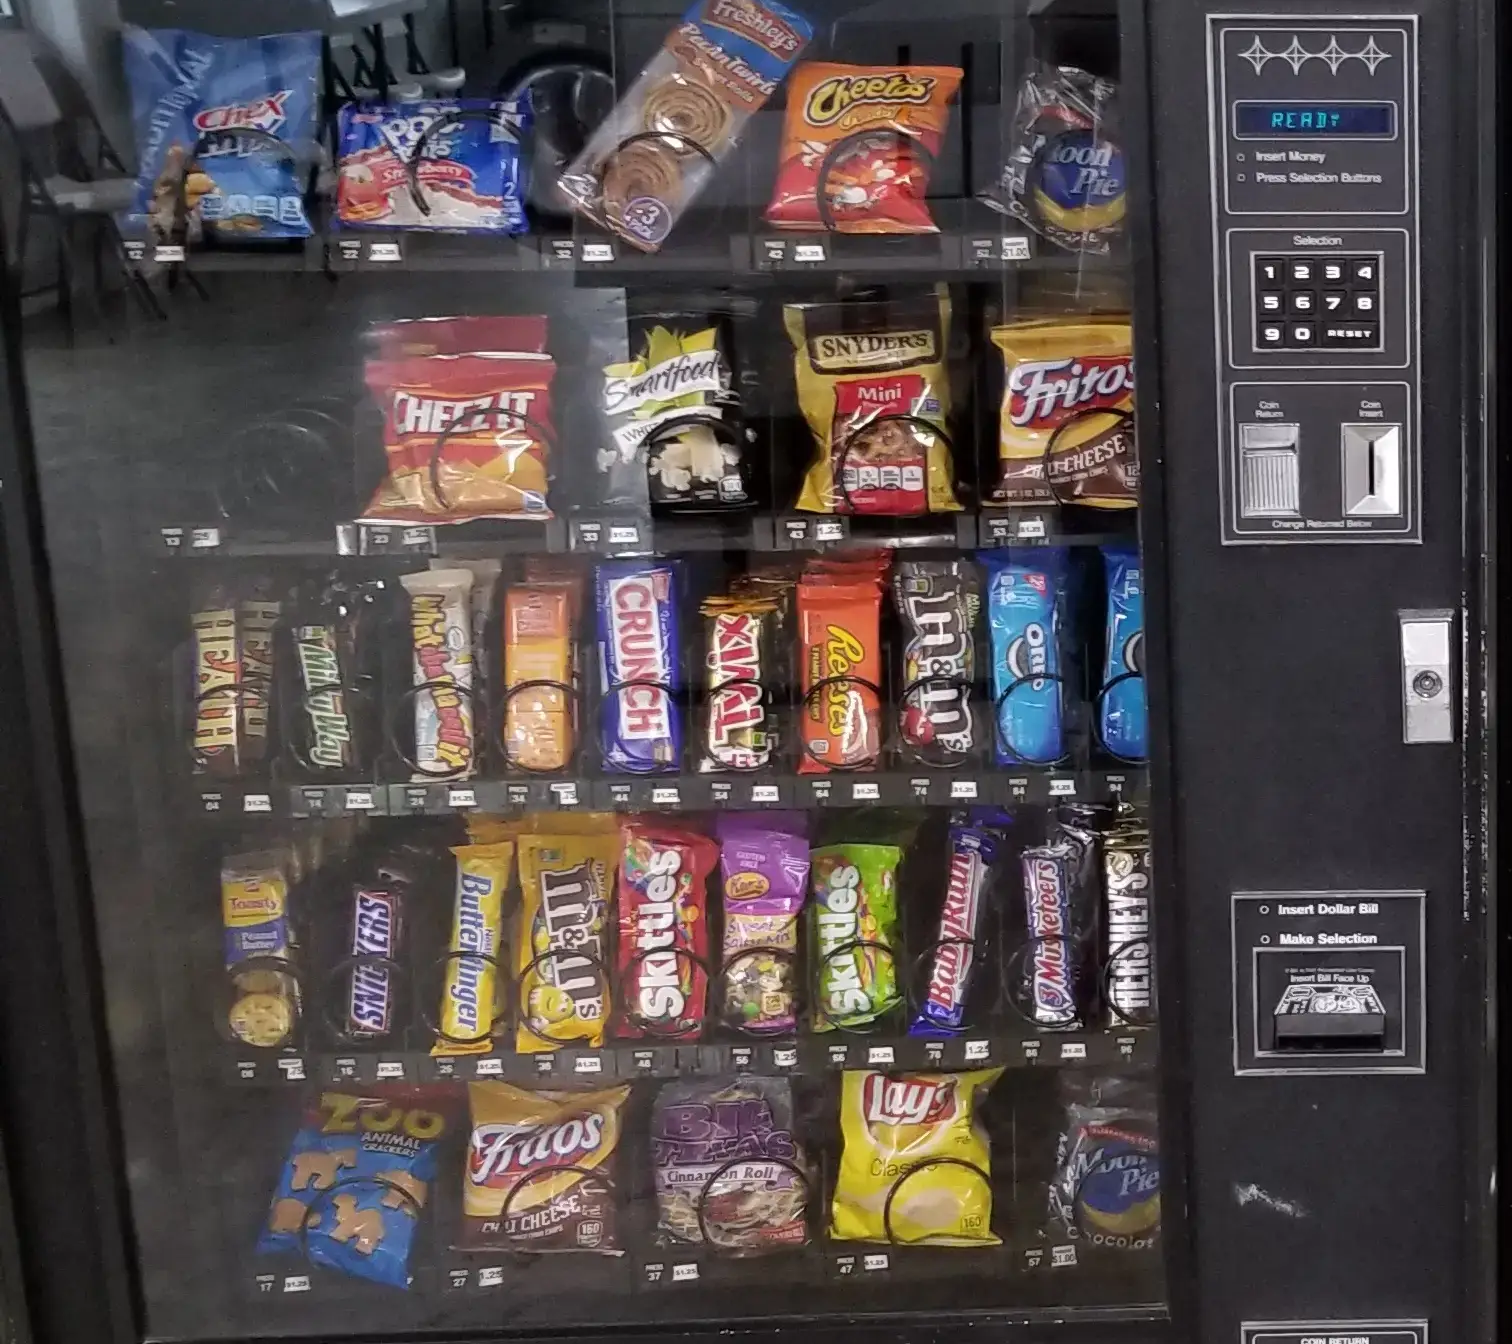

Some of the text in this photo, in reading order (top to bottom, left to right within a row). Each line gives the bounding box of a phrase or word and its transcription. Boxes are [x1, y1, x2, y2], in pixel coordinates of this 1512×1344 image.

[727, 54, 779, 97] Twirls
[806, 75, 936, 125] Cheetos
[196, 90, 295, 134] Chex
[1271, 112, 1340, 129] READY
[1256, 152, 1326, 164] Insert Money
[1070, 168, 1120, 196] Pie
[1256, 172, 1382, 184] Press Selection Buttons
[1293, 235, 1343, 247] Selection
[1264, 267, 1276, 279] 1
[1294, 267, 1310, 279] 2
[1325, 267, 1341, 279] 3
[1357, 267, 1372, 279] 4
[1263, 297, 1279, 309] 5
[1295, 297, 1310, 309] 6
[1325, 297, 1341, 310] 7
[1357, 297, 1372, 309] 8
[1264, 328, 1280, 341] 9
[1295, 328, 1311, 340] 0
[1328, 330, 1372, 338] RESET
[822, 332, 930, 358] SNYDER'S
[603, 355, 719, 412] Smartfood
[857, 382, 902, 402] Mini
[1064, 433, 1126, 473] CHEESE
[1272, 519, 1305, 530] Change
[613, 584, 666, 734] CRUNCH
[1024, 624, 1046, 691] OREO
[710, 613, 765, 748] TWIX
[826, 624, 866, 736] Reese's
[308, 712, 351, 768] Way
[914, 786, 928, 796] 74
[731, 878, 767, 895] Kar's
[1278, 903, 1379, 915] Insert Dollar Bill
[1037, 859, 1066, 984] Musketeers
[638, 850, 685, 1018] Skittles
[819, 864, 872, 1014] Skittles
[1107, 872, 1151, 1009] HERSHEY'S
[1279, 933, 1378, 945] Make Selection
[450, 872, 492, 1033] Butterfinger
[352, 896, 392, 1030] SNICKERS
[1290, 974, 1370, 984] Insert Bill Face Up
[1120, 1045, 1133, 1054] 96
[735, 1055, 749, 1065] 56
[866, 1074, 955, 1125] Lay's
[321, 1091, 446, 1139] ZOO
[359, 1130, 421, 1152] ANIMAL
[652, 1130, 798, 1166] TEXAS
[362, 1142, 417, 1159] CRACKERS
[471, 1113, 606, 1185] Fritos
[743, 1166, 775, 1180] Roll
[1119, 1167, 1160, 1197] Pie
[520, 1193, 582, 1232] CHEESE
[581, 1223, 600, 1235] 160
[963, 1215, 982, 1229] 160
[647, 1271, 662, 1282] 37
[675, 1268, 697, 1277] $1.25
[839, 1264, 853, 1274] 47
[260, 1282, 273, 1293] 17
[452, 1277, 467, 1287] 27
